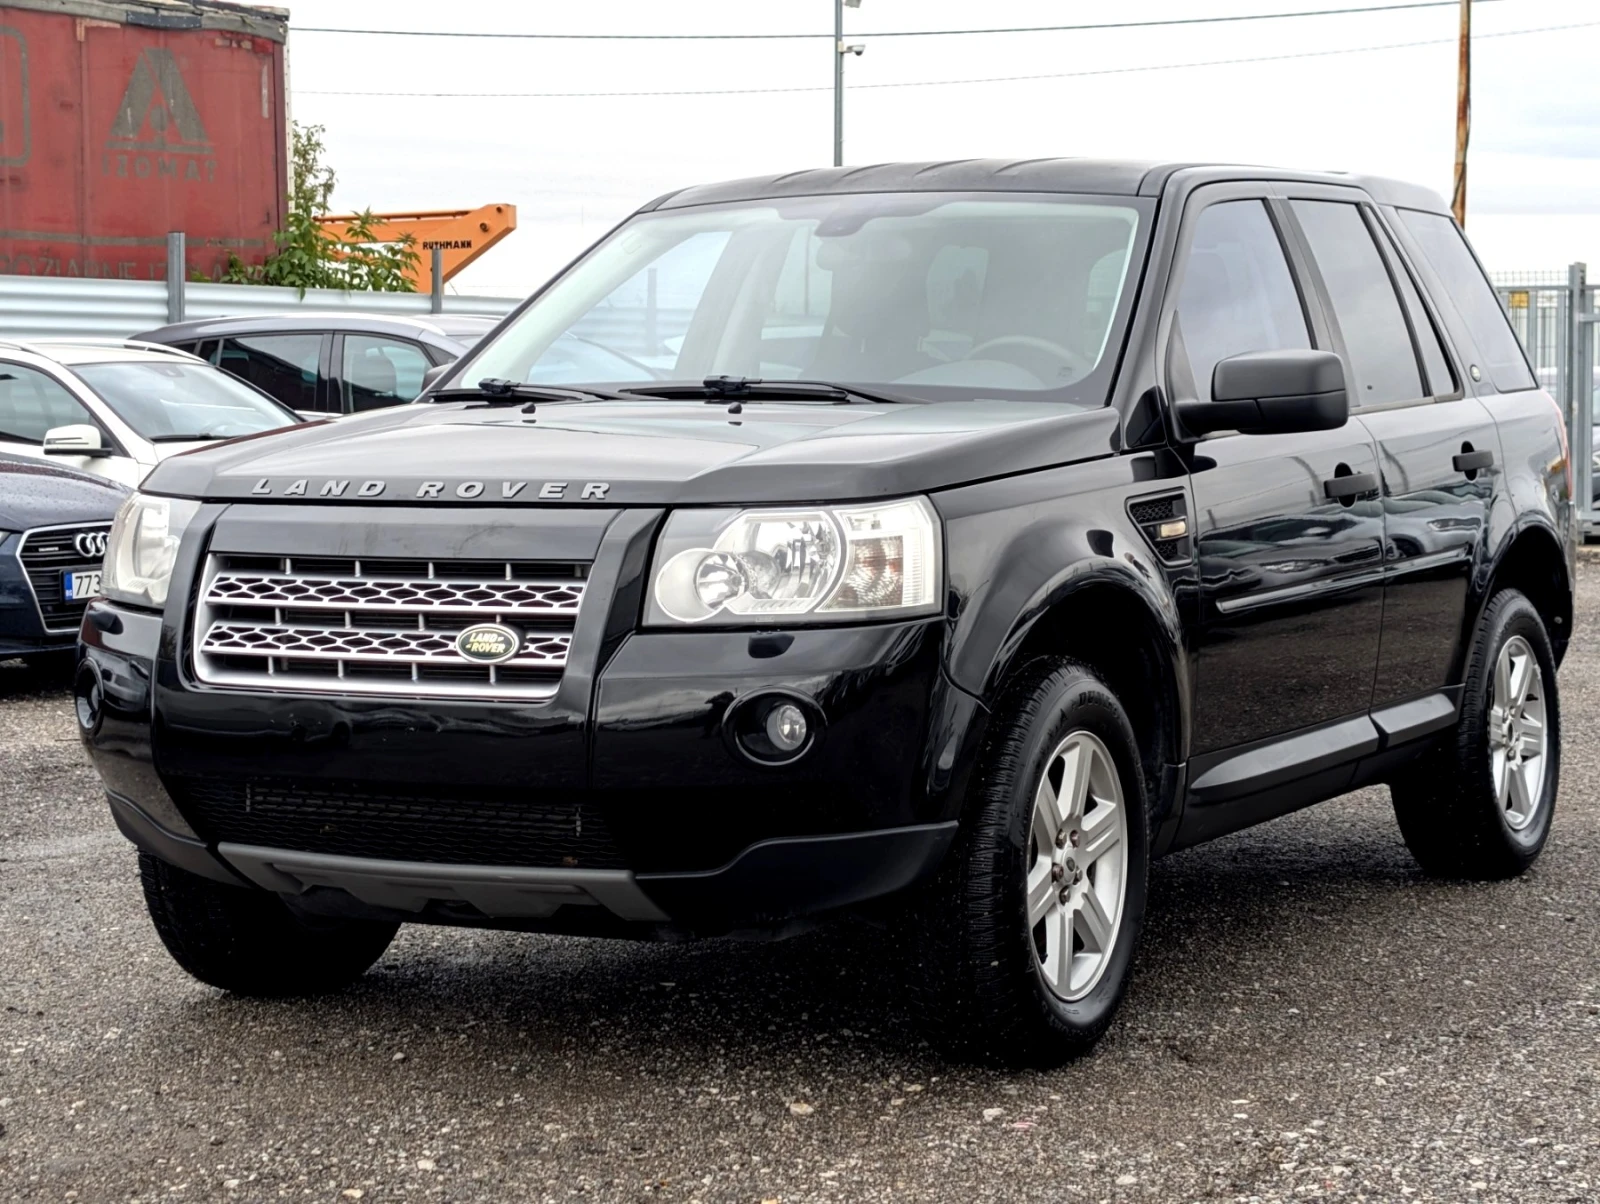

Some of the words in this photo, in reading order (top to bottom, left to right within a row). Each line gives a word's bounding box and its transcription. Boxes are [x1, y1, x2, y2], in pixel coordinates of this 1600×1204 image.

[101, 153, 218, 183] IZOMAT
[422, 240, 472, 250] RUTHMANN
[251, 478, 386, 497] LAND
[416, 481, 611, 499] ROVER
[75, 574, 100, 596] 773
[470, 633, 498, 643] LAND
[471, 643, 506, 653] ROVER
